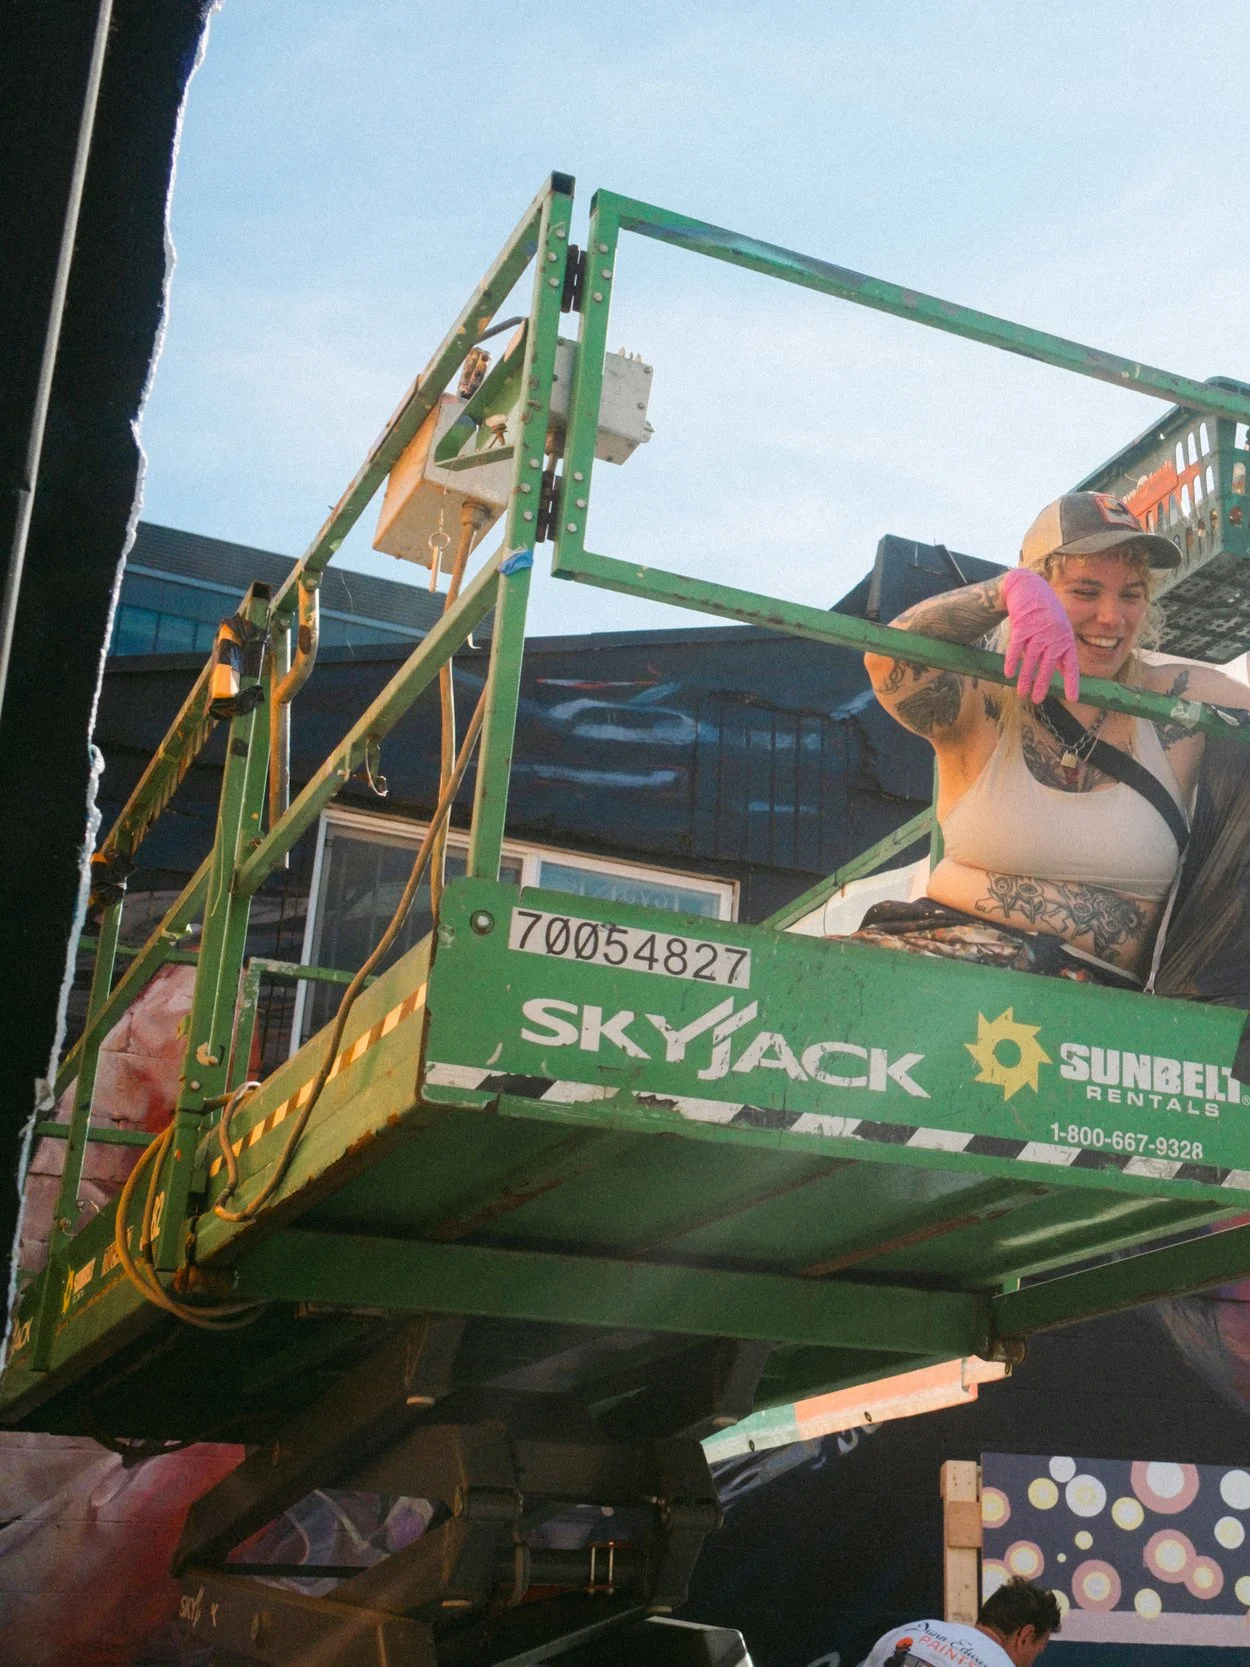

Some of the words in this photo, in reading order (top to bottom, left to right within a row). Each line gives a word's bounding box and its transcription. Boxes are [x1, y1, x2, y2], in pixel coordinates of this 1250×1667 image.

[517, 910, 748, 984] 70054827
[520, 996, 931, 1098] SKYJACK
[1086, 1085, 1219, 1117] RENTALS
[1051, 1122, 1203, 1160] 1-800-667-9328
